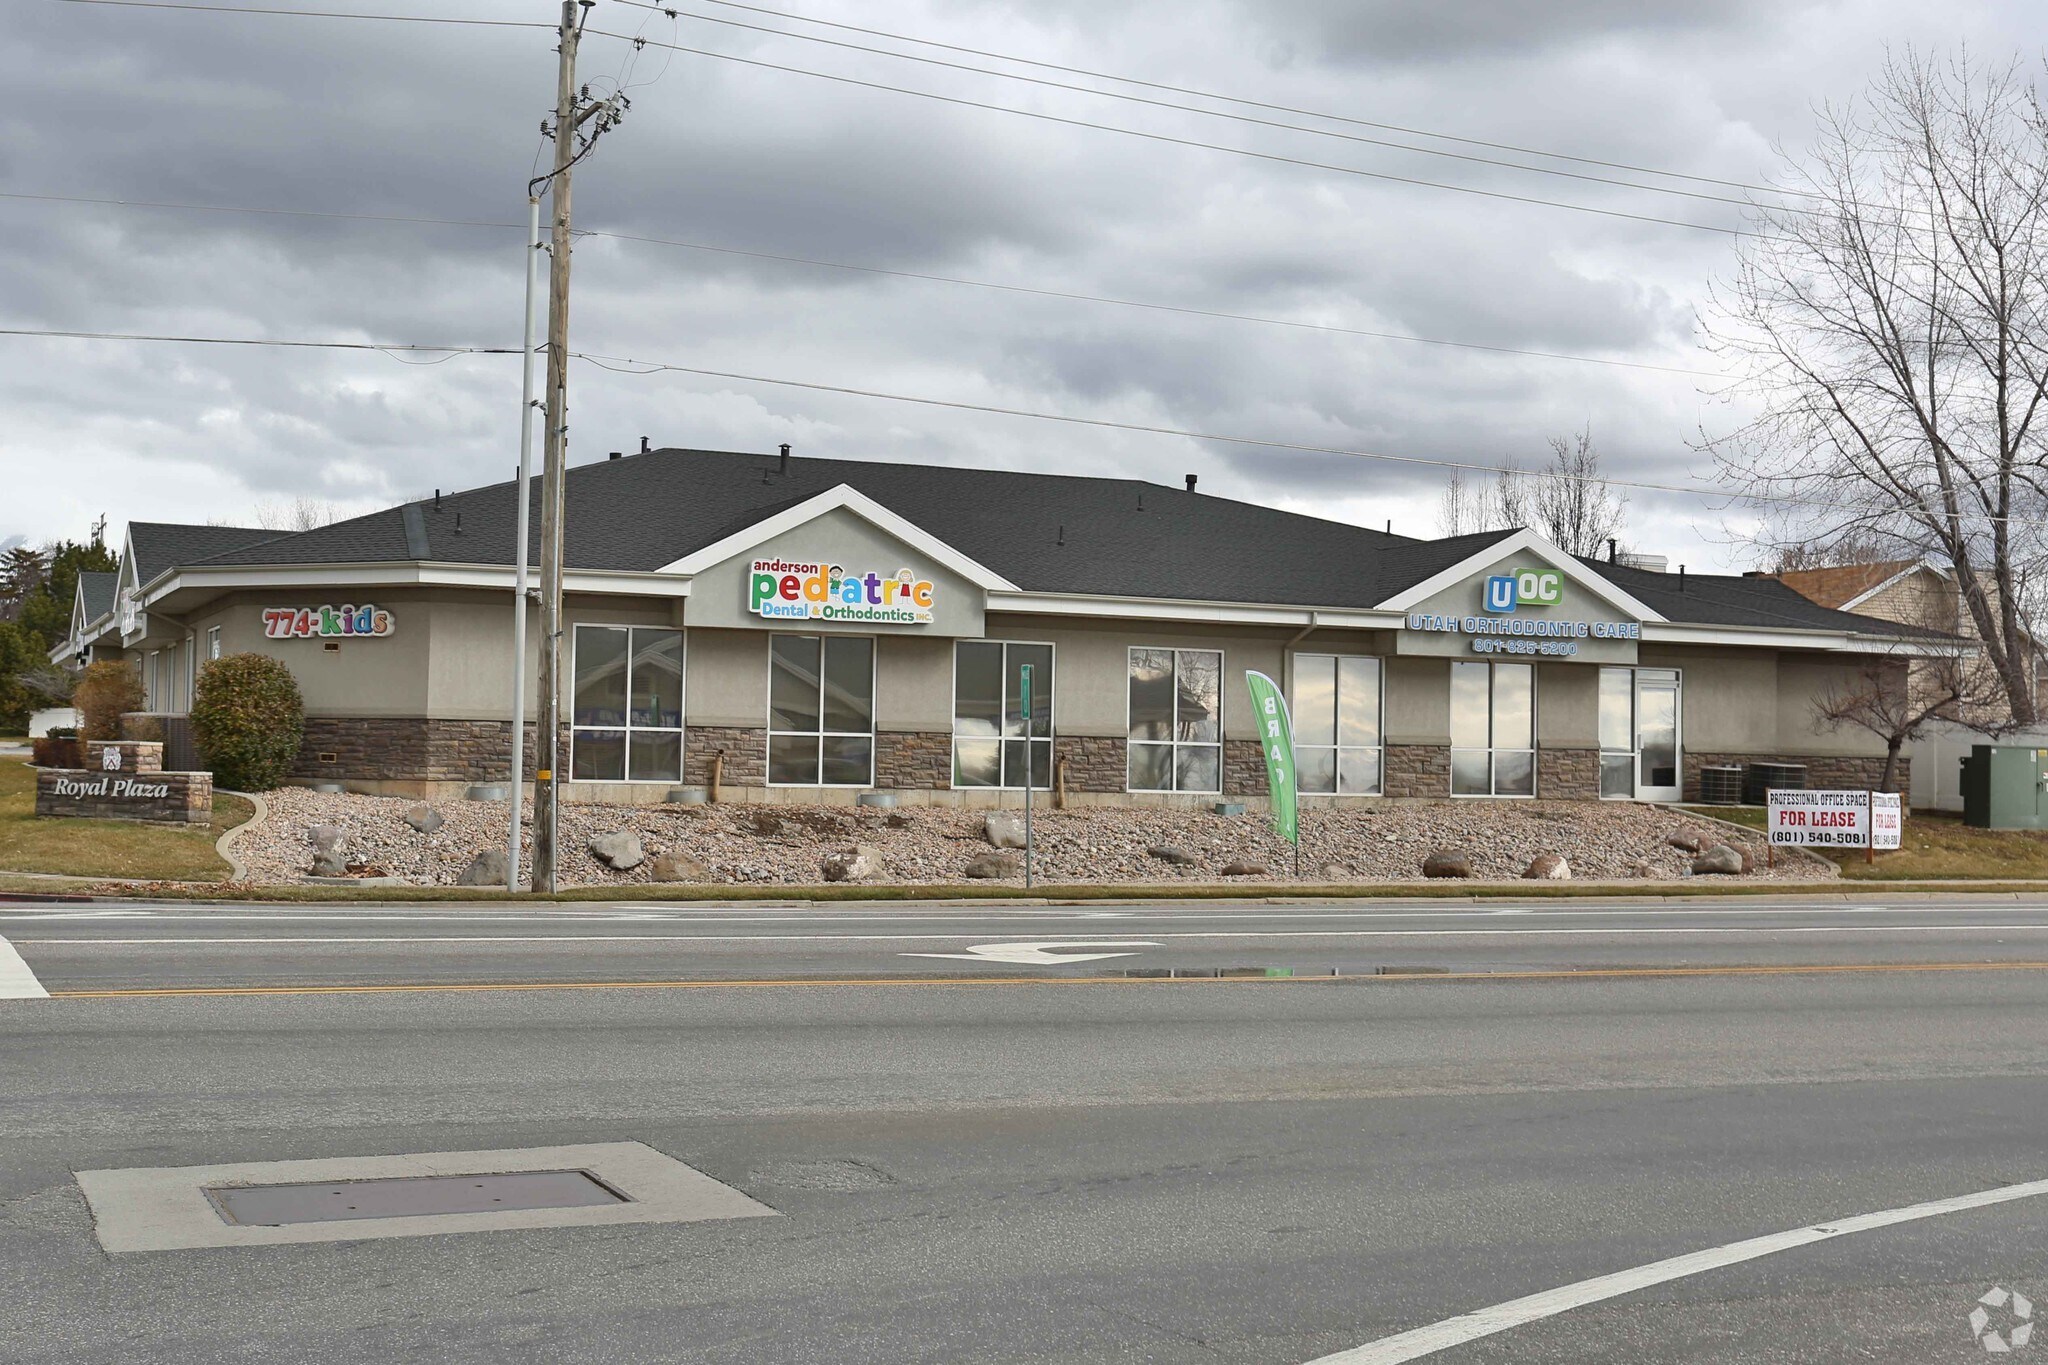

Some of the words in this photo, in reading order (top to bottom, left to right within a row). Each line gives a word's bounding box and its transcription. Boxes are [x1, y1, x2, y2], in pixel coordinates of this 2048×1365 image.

[754, 559, 818, 574] anderson
[762, 602, 808, 617] Dental
[812, 606, 820, 616] &
[823, 605, 914, 621] Orthodontics
[916, 613, 932, 621] INC.
[265, 607, 387, 635] 774-kids
[1410, 614, 1458, 632] UTAH
[1465, 617, 1588, 637] ORTHODONTIC
[1594, 622, 1639, 638] CARE
[1474, 638, 1578, 655] 801-825-5200
[54, 777, 108, 799] Royal
[111, 778, 169, 798] Plaza
[1770, 793, 1818, 806] PROFESSIONAL
[1821, 794, 1844, 806] OFFICE
[1846, 794, 1867, 806] SPACE
[1780, 811, 1806, 825] FOR
[1811, 812, 1856, 827] LEASE
[1772, 831, 1804, 844] (801)
[1809, 833, 1867, 844] 540-5081
